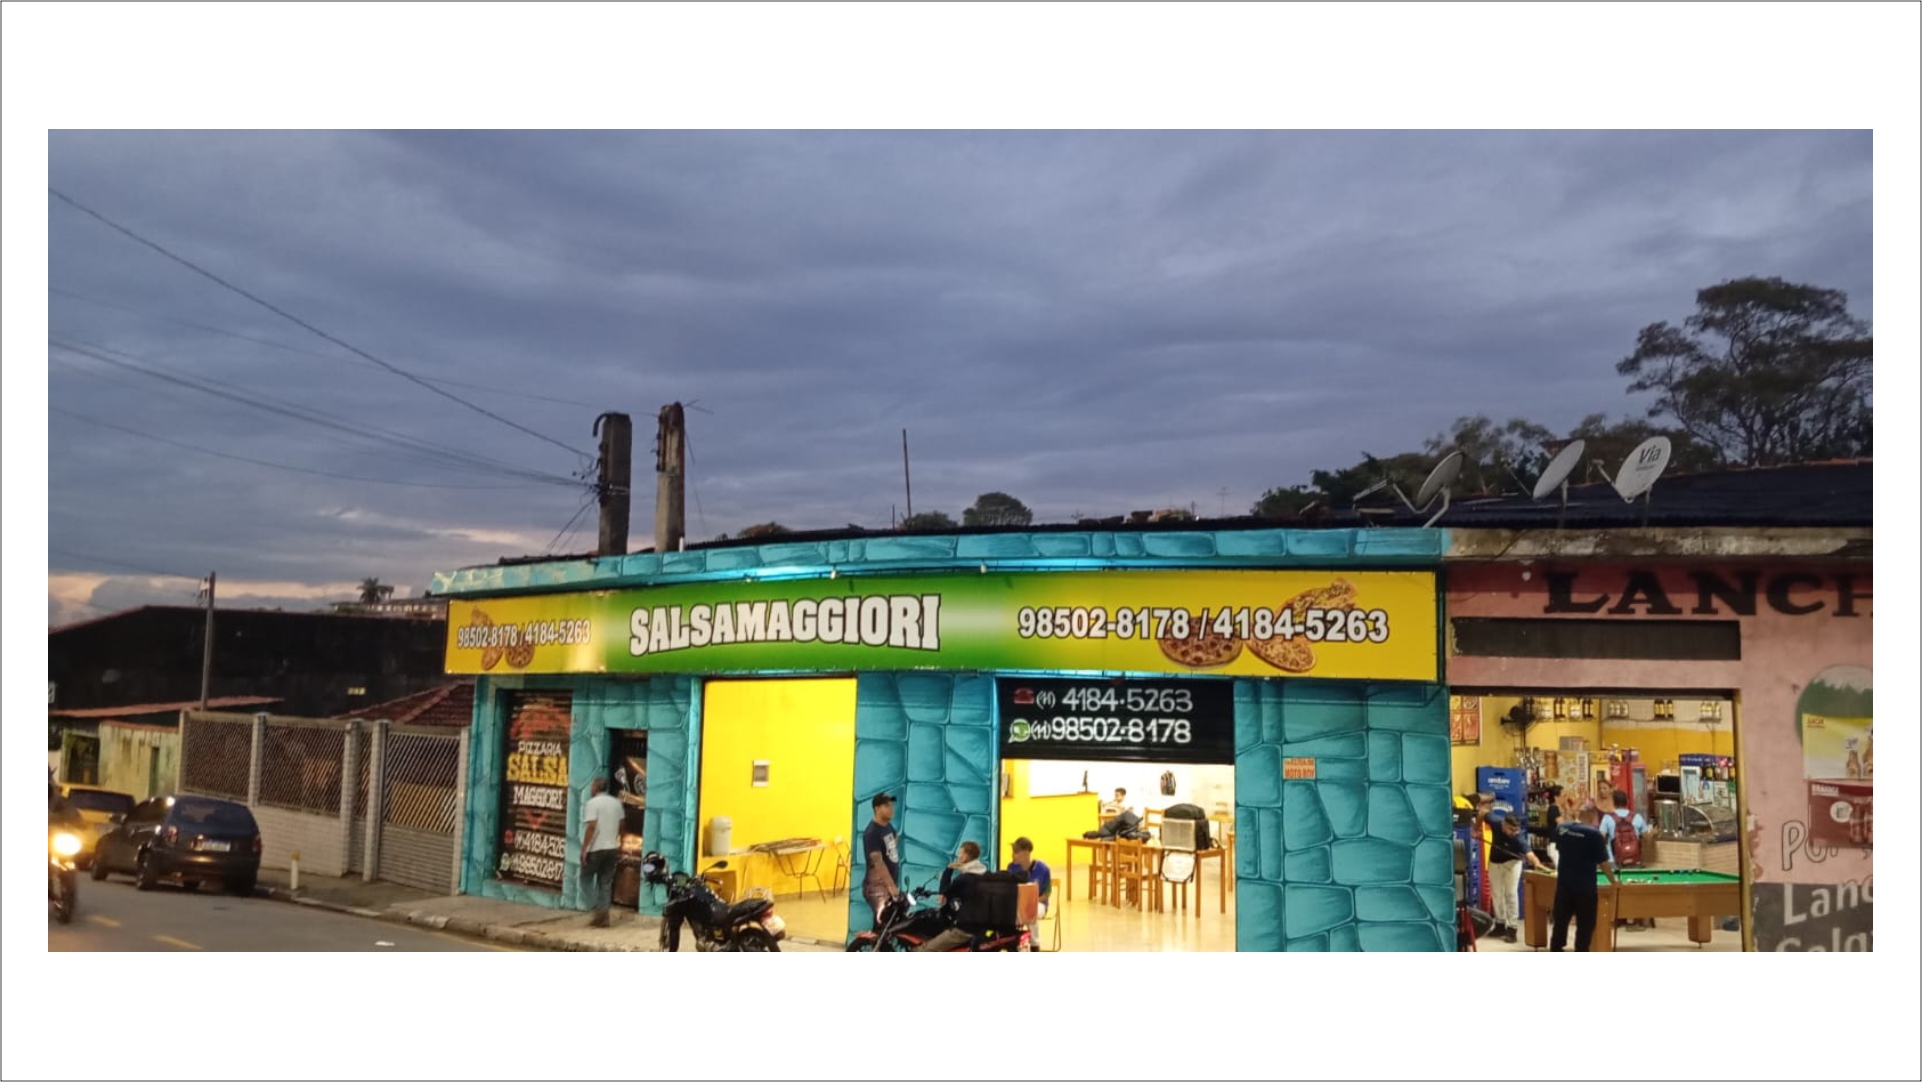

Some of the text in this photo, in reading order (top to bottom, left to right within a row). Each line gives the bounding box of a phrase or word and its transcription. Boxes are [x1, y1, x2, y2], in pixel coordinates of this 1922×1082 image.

[457, 624, 518, 649] 98502-8178
[525, 618, 591, 645] 4184-5263
[629, 593, 940, 657] SALSAMAGGIORI
[1017, 606, 1191, 640] 98502-8178
[1212, 607, 1389, 642] 4184-5263
[518, 740, 562, 756] PIZZARIA
[506, 752, 568, 787] SALSA
